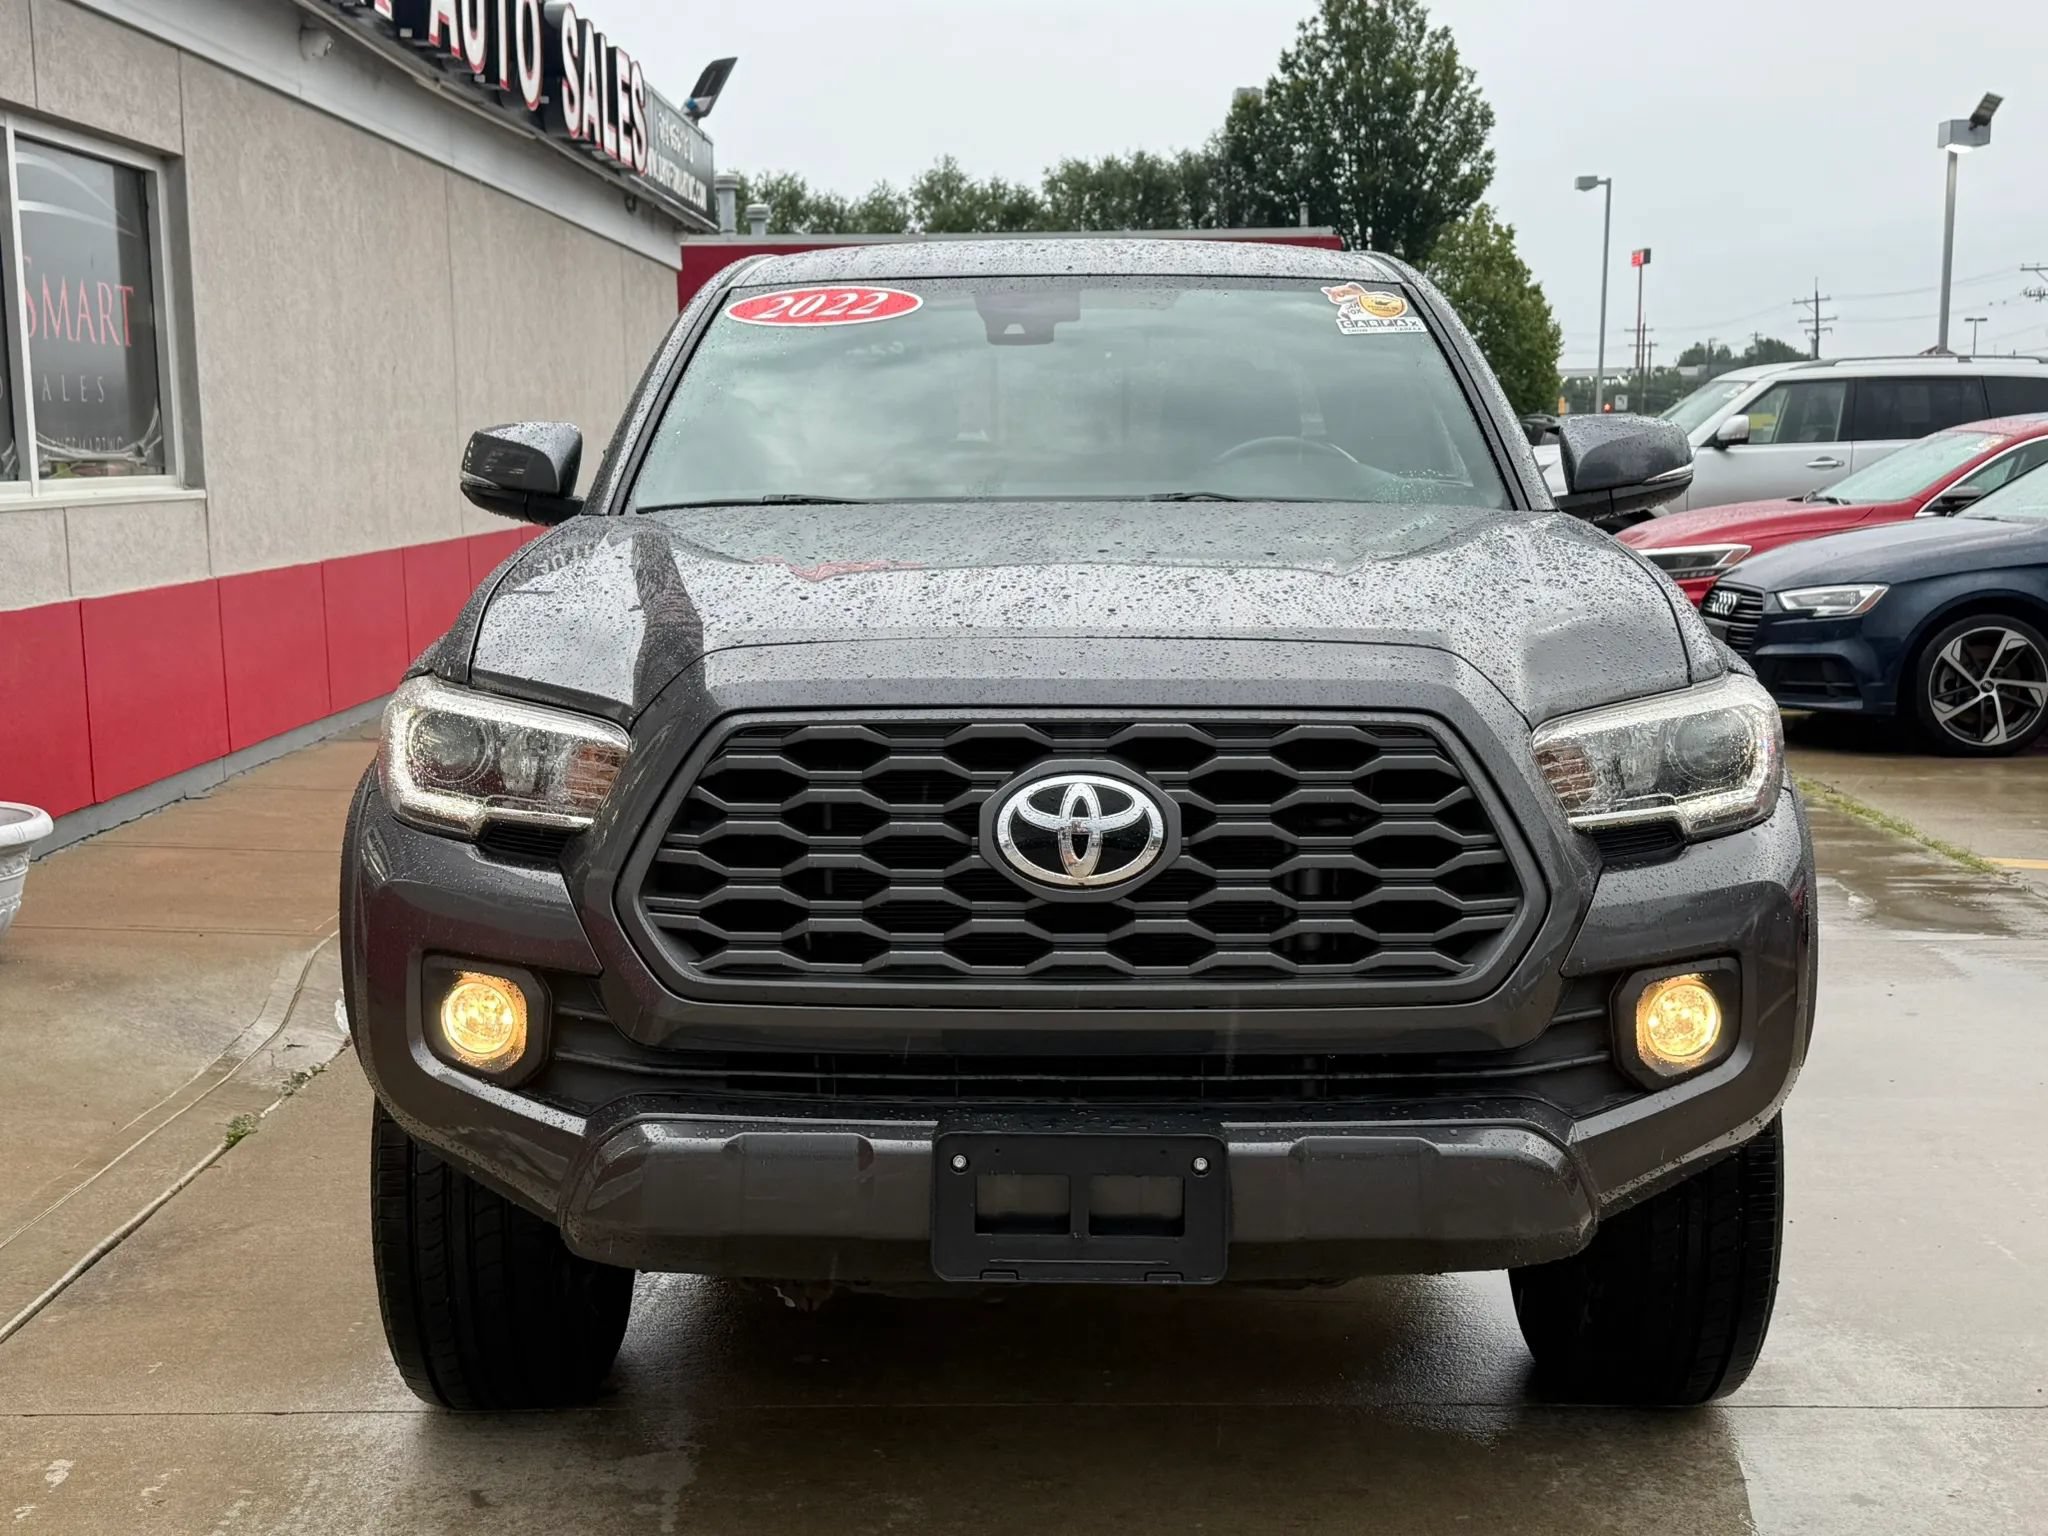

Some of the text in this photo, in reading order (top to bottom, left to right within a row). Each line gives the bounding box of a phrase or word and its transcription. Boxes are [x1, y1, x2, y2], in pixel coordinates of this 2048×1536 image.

[562, 3, 648, 176] SALES
[752, 292, 889, 319] 2022
[1340, 319, 1419, 329] CARFAX
